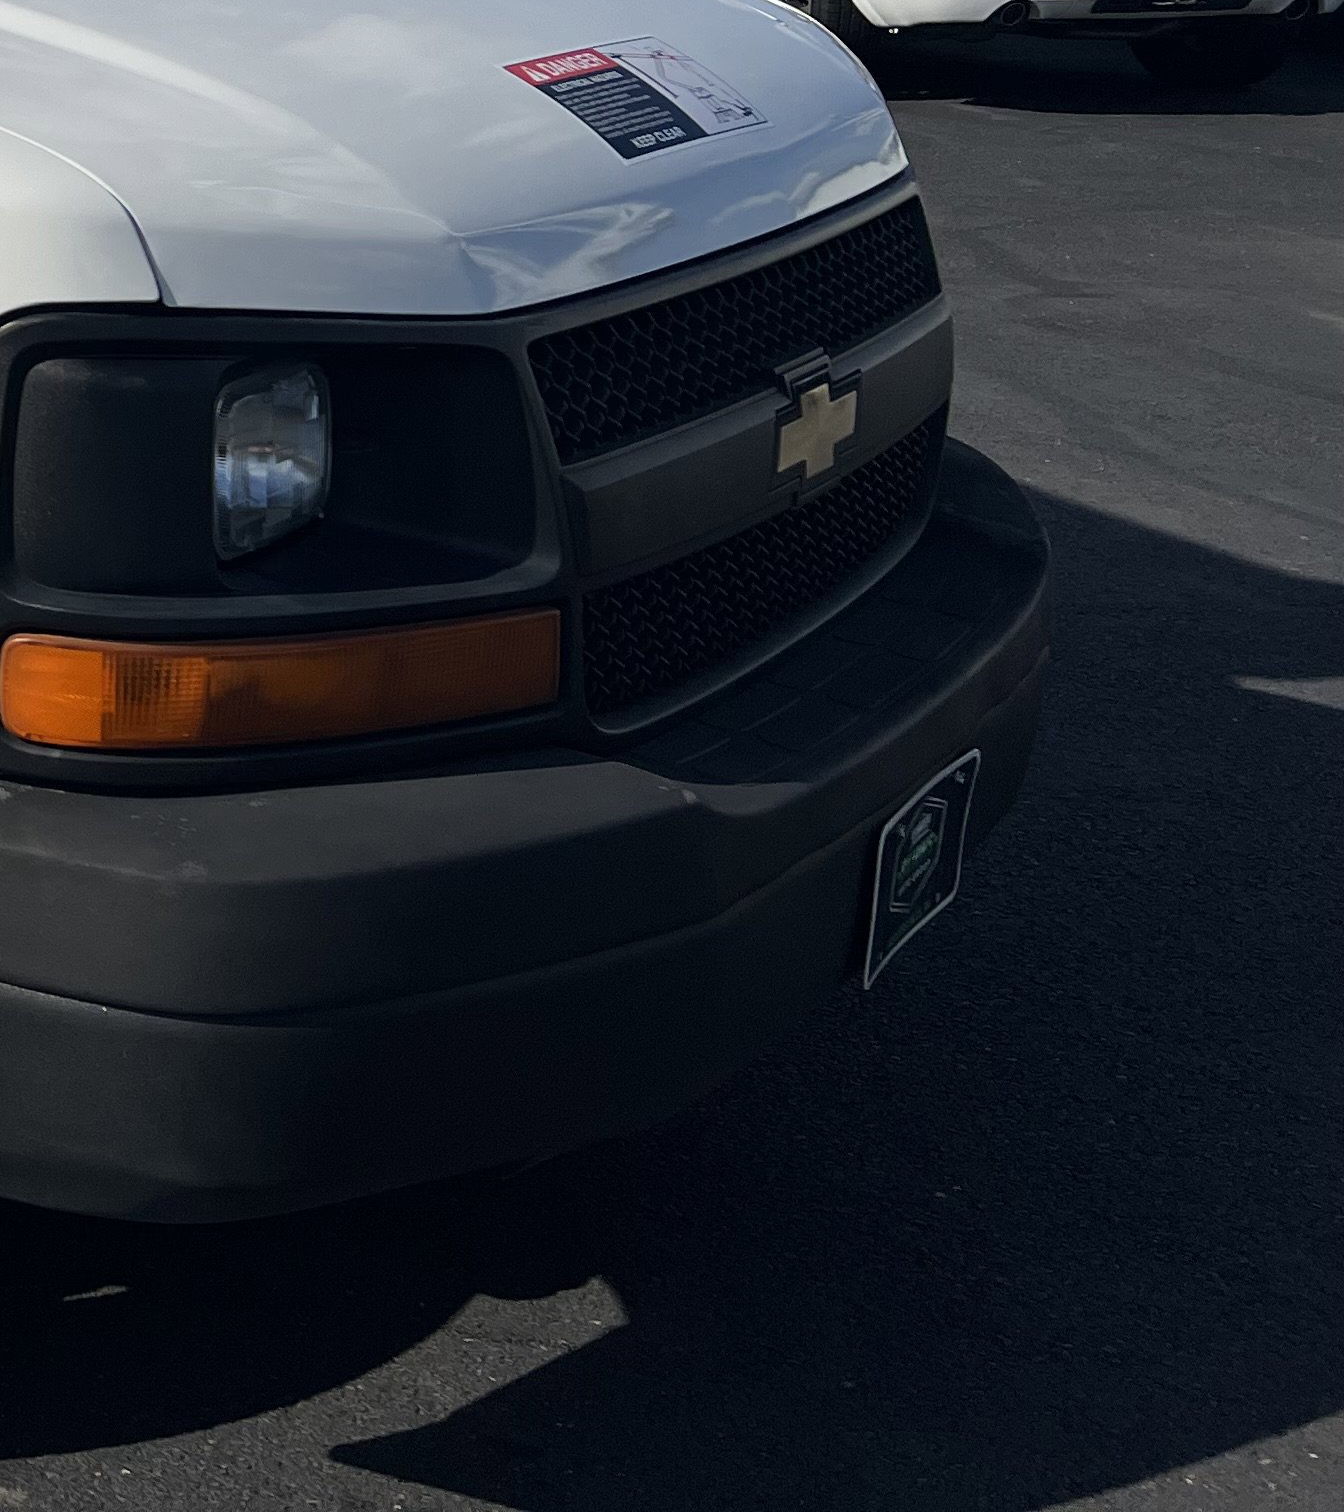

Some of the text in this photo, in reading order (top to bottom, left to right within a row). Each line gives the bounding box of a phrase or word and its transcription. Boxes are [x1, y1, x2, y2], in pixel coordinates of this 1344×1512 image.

[543, 52, 609, 77] DANGER
[630, 126, 688, 149] KEEP CLEAR
